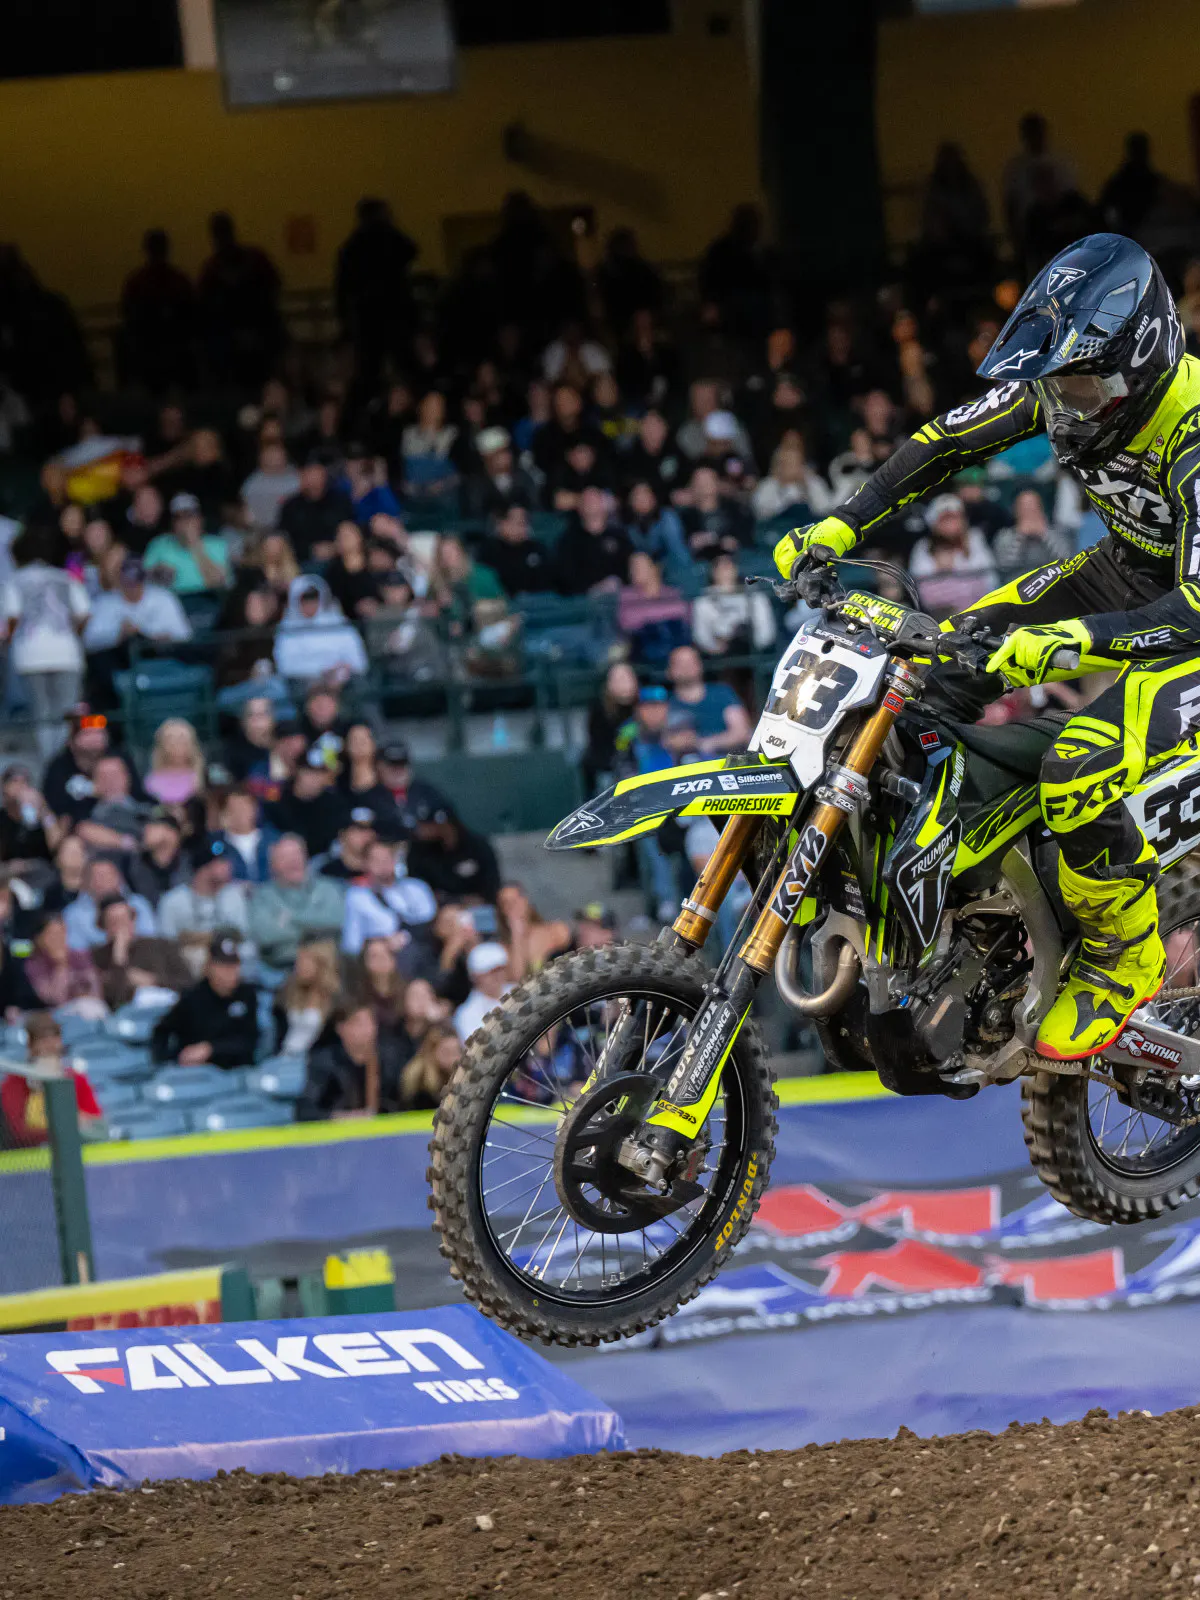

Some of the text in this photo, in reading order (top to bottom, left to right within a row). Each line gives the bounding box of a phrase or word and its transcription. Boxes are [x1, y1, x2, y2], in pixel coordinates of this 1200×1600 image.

[1110, 517, 1176, 553] TRIUMPH
[840, 604, 896, 631] RENHAL
[848, 593, 905, 619] RENTHAL
[763, 649, 858, 730] 33
[671, 779, 713, 796] FXR
[737, 773, 783, 784] Silkolene
[1043, 768, 1128, 821] FXR
[702, 797, 783, 812] PROGRESSIVE
[770, 824, 827, 925] KYB
[910, 831, 954, 878] TRIUMPH
[690, 1008, 731, 1085] PERFORMANCE
[694, 1034, 725, 1091] LUBRICANTS
[658, 1101, 697, 1125] ACERBIS
[714, 1160, 758, 1251] DUNLOP
[46, 1329, 485, 1394] FALKEN
[414, 1378, 520, 1404] TIRES
